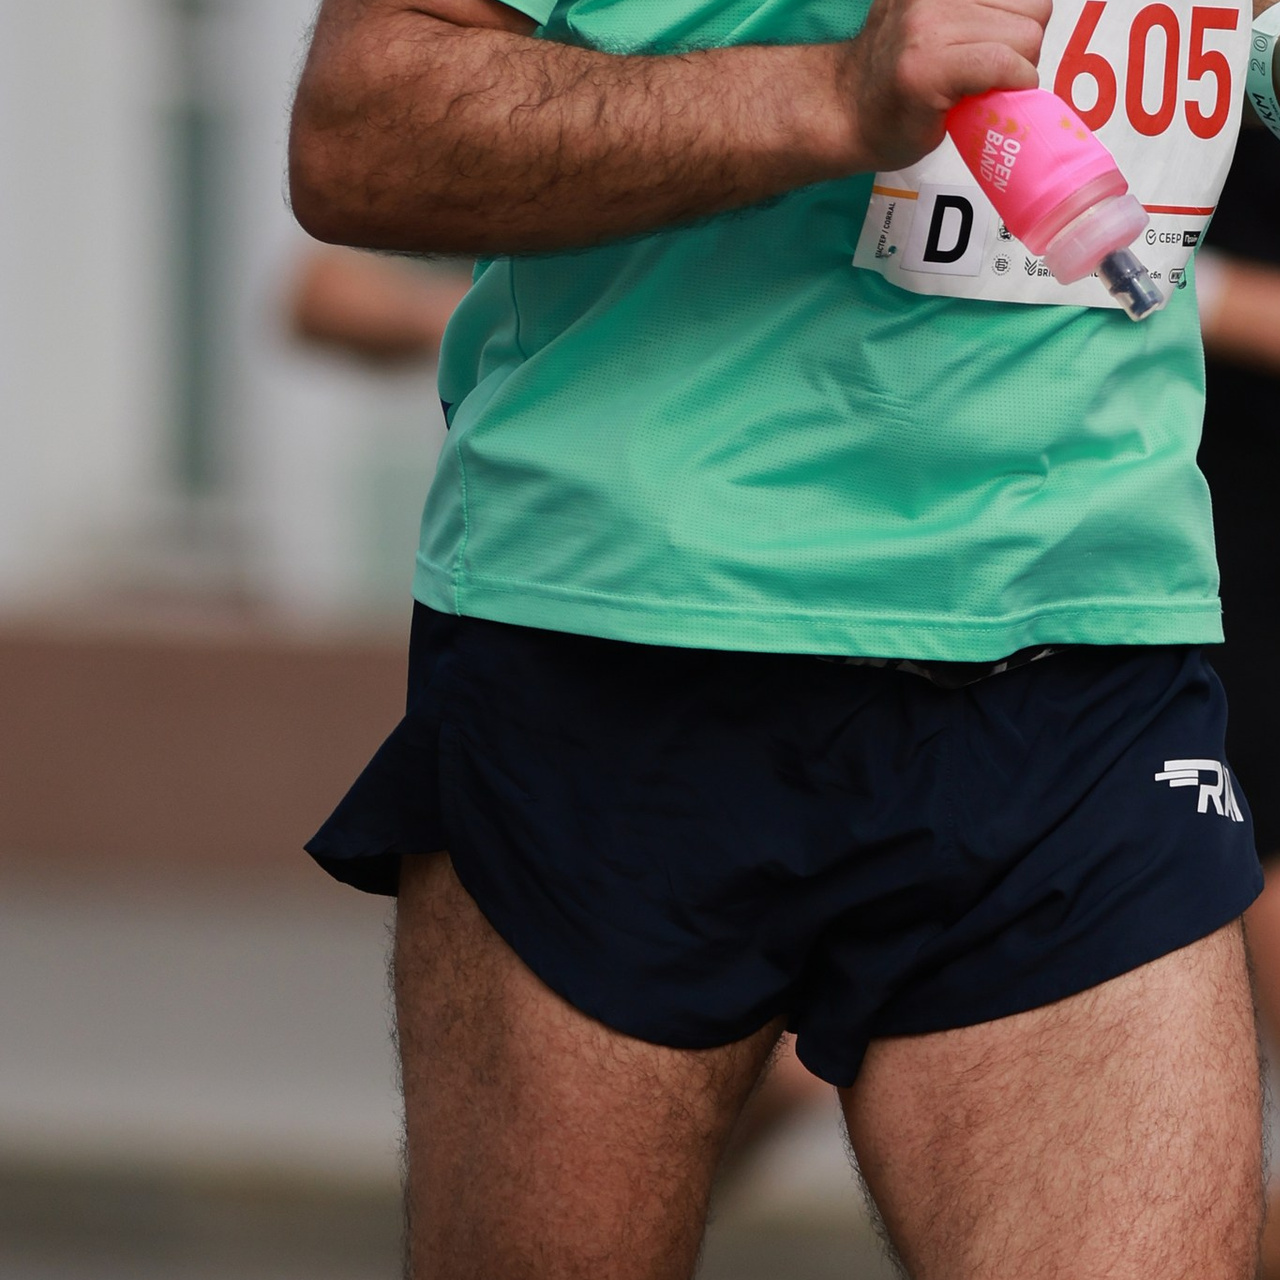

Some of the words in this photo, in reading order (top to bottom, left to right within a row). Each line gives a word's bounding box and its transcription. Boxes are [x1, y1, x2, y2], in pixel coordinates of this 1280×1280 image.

[980, 129, 1004, 182] BAND
[994, 138, 1021, 194] OPEN
[883, 202, 896, 229] CORRAL
[923, 194, 974, 264] D
[1159, 232, 1182, 244] СБЕР
